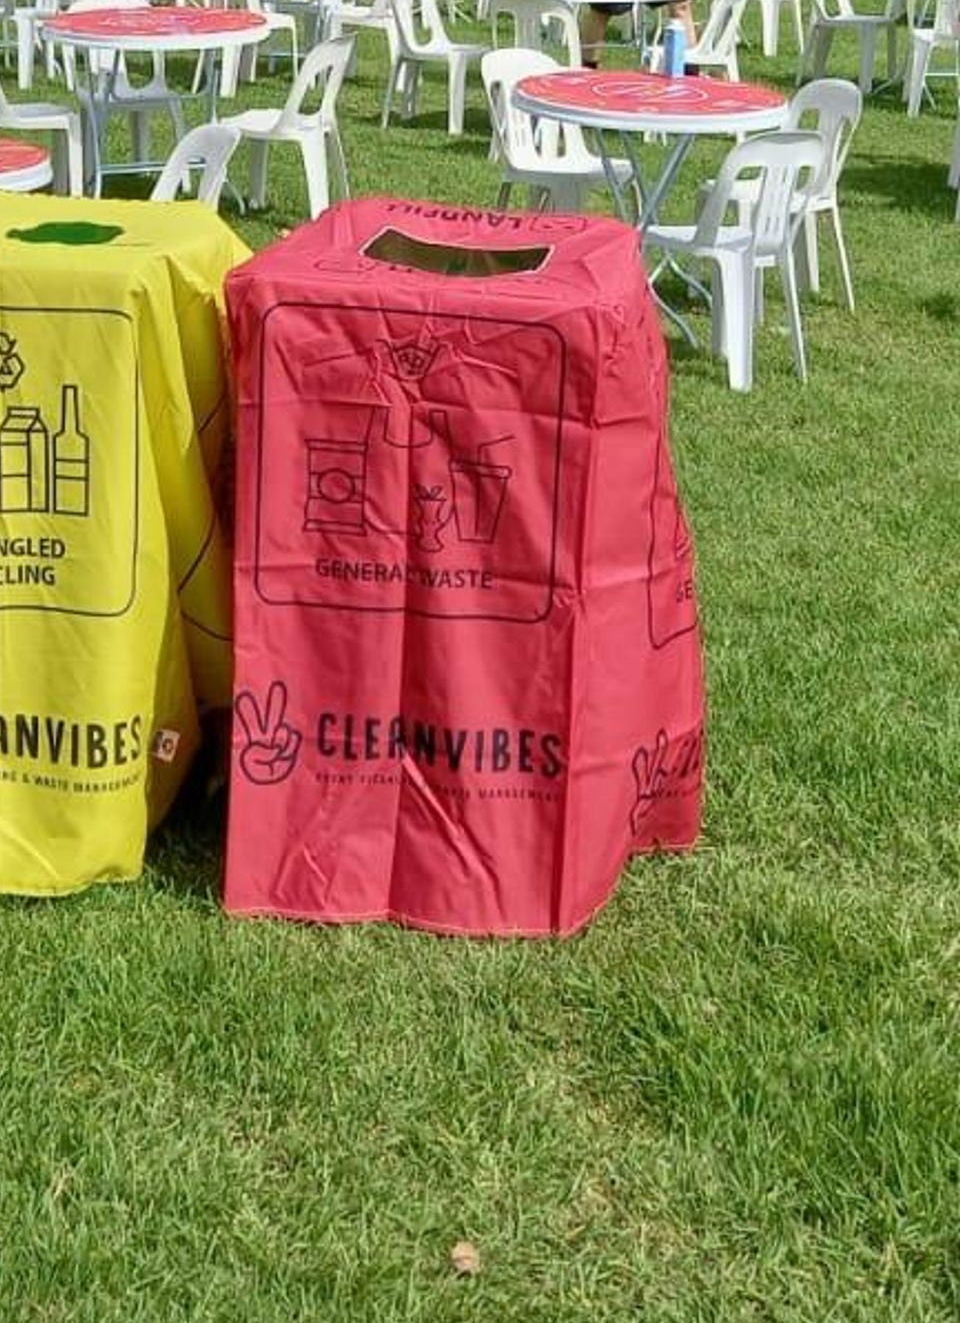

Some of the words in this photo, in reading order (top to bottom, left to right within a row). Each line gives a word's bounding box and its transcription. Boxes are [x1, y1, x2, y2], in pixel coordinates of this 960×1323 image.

[386, 203, 521, 229] LANDFILL
[418, 568, 493, 590] WASTE
[317, 712, 563, 779] CLEANVIBES
[35, 774, 69, 792] WASTE
